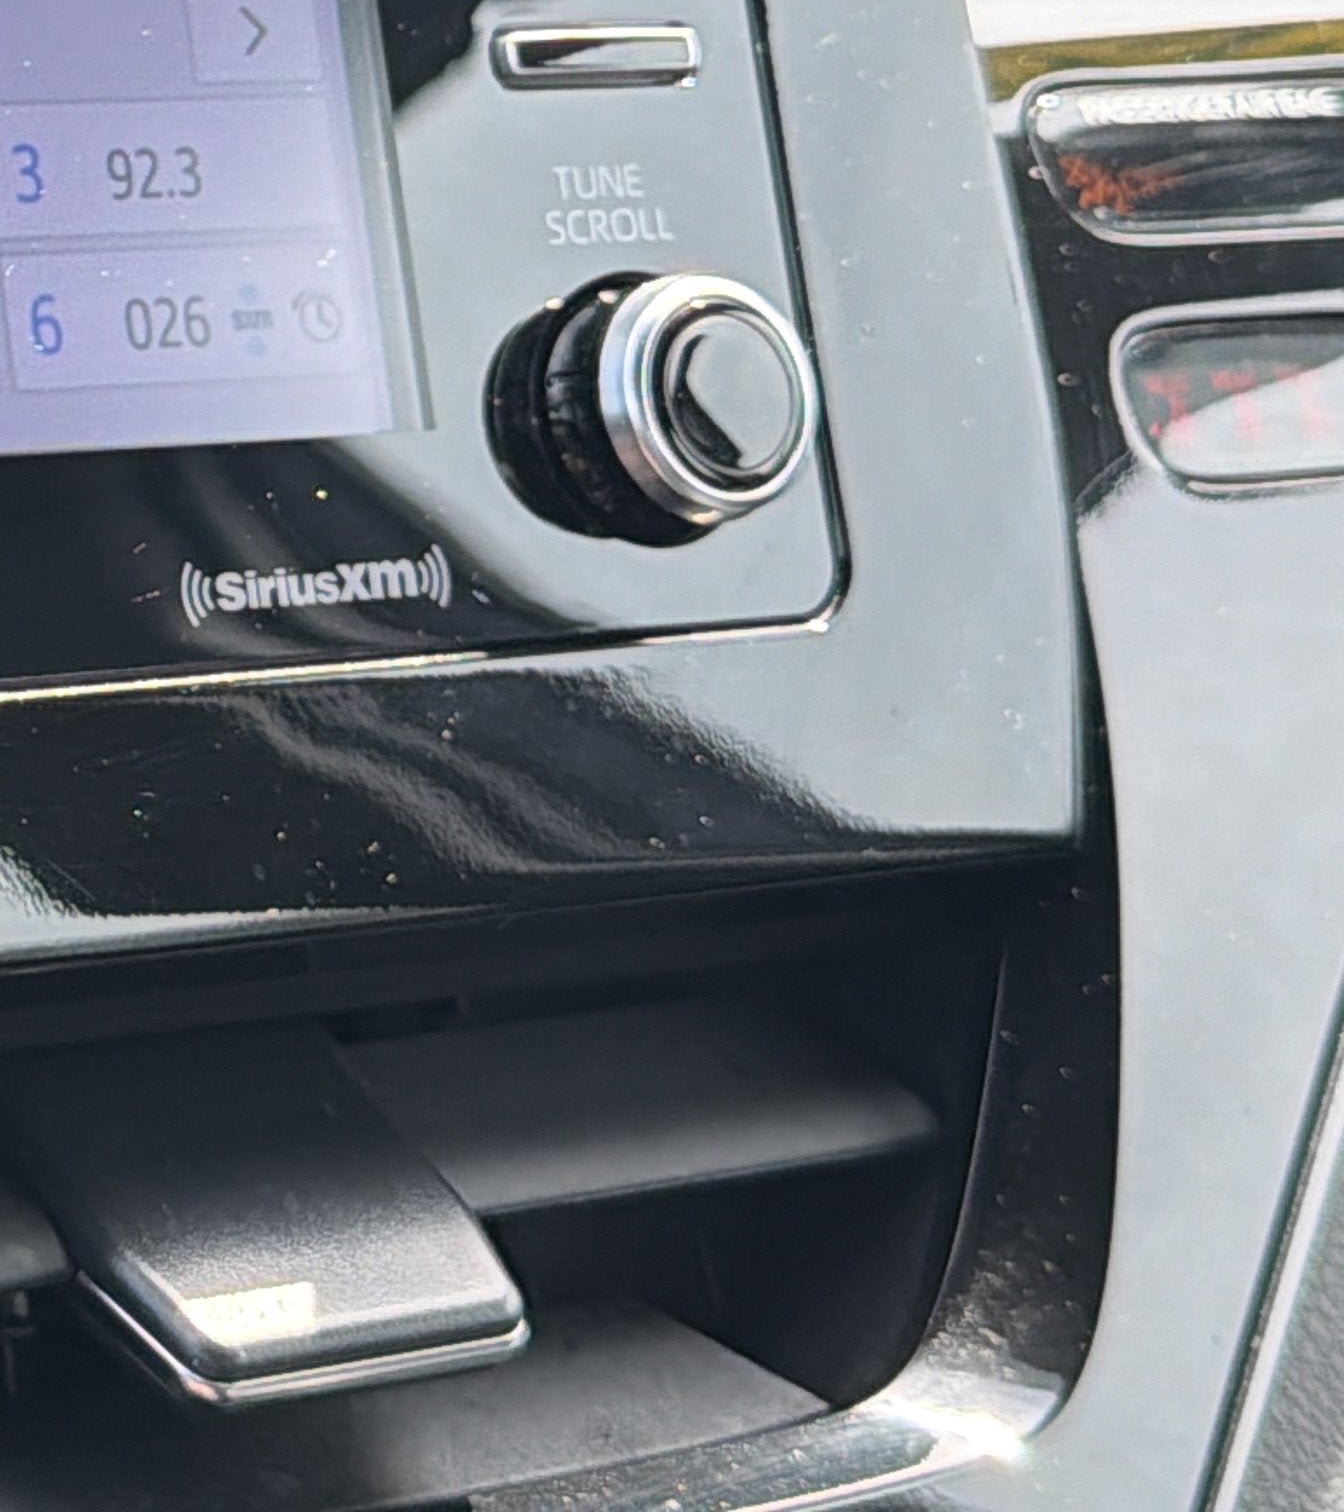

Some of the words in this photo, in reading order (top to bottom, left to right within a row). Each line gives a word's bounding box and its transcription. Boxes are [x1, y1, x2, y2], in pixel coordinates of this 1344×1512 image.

[12, 143, 45, 204] 3
[105, 145, 204, 201] 92.3
[551, 163, 646, 200] TUNE
[545, 207, 675, 245] SCROLL
[28, 294, 64, 356] 6
[123, 297, 212, 351] 026
